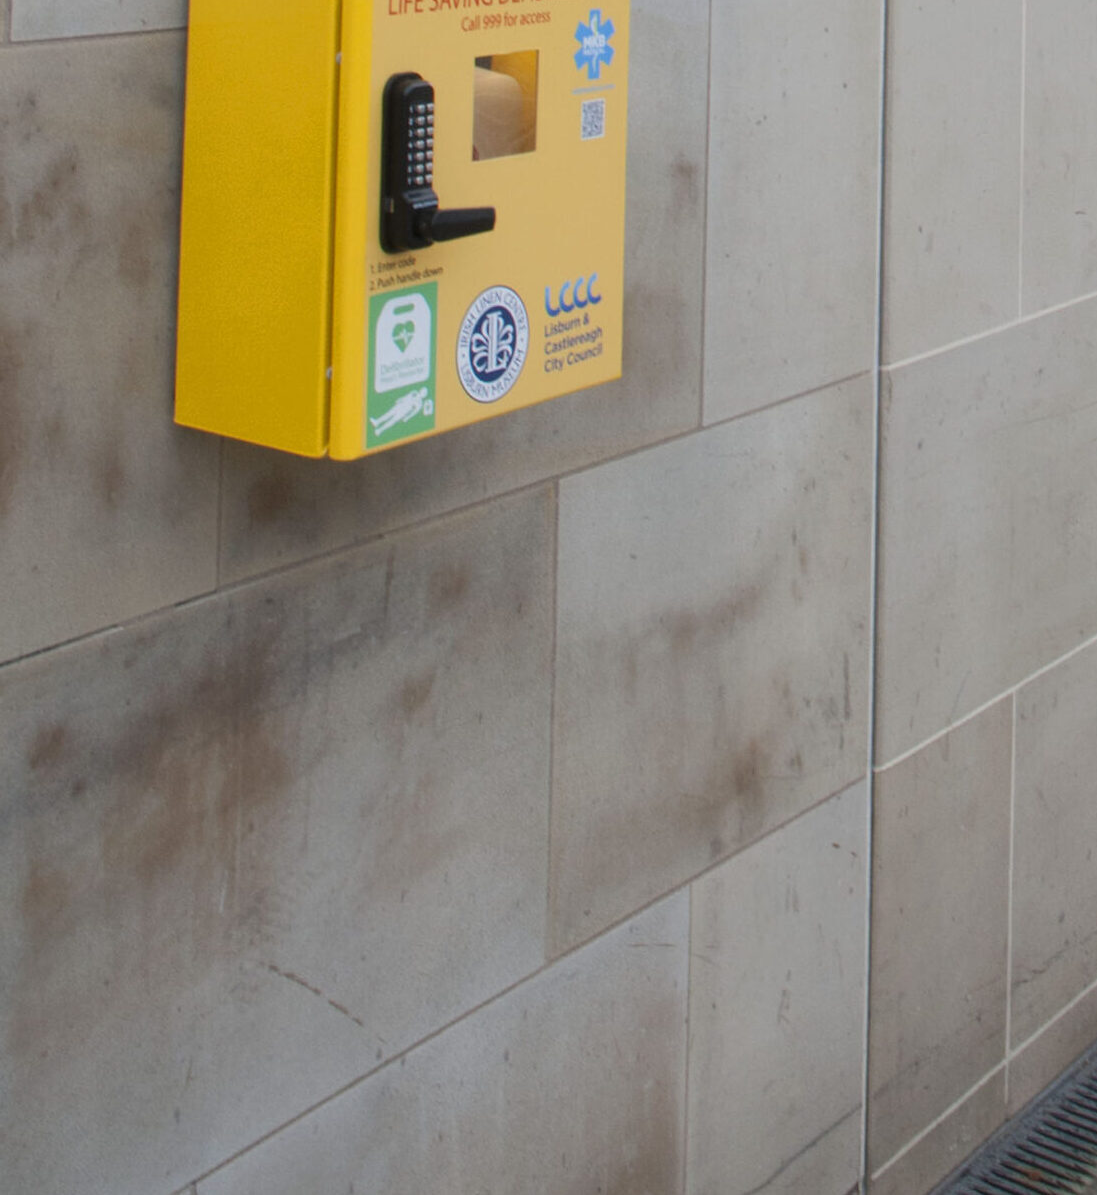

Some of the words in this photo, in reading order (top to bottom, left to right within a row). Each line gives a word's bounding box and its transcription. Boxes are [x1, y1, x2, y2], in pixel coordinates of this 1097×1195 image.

[461, 15, 481, 32] Call
[483, 12, 502, 30] 999
[504, 12, 518, 26] for
[520, 12, 551, 25] access
[377, 275, 395, 288] Push
[396, 268, 422, 283] handle
[423, 266, 444, 278] down
[544, 272, 602, 317] LCCC
[544, 314, 581, 338] Lisburn
[582, 312, 590, 326] &
[544, 326, 603, 355] Castlereagh
[544, 356, 564, 373] City
[567, 343, 603, 366] Council
